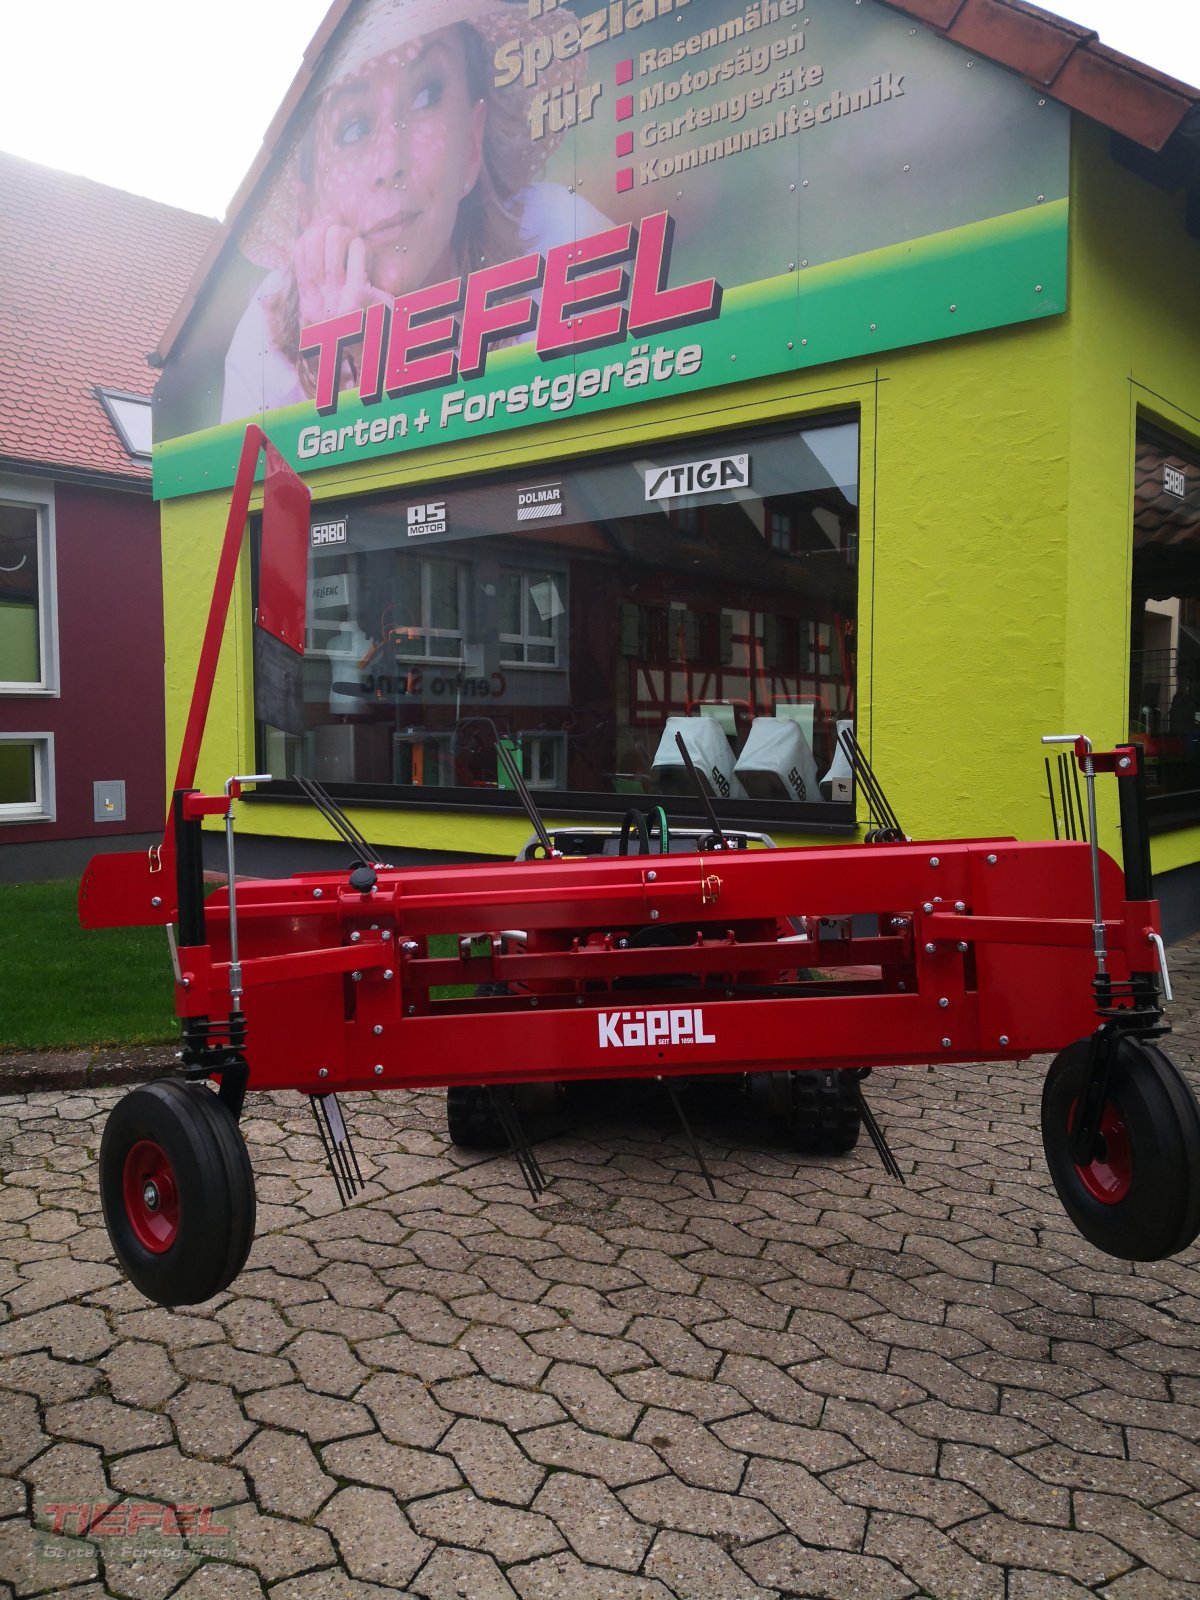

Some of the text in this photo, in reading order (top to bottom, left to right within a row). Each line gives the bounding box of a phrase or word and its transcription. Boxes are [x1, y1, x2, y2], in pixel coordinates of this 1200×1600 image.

[494, 0, 690, 87] Spezia
[639, 32, 805, 112] Motorsägen
[528, 81, 602, 141] für
[639, 63, 824, 148] Gartengeräte
[639, 71, 905, 186] Kommunaltechnik
[299, 210, 721, 415] TIEFEL
[297, 343, 702, 460] Garten + Forstgeräte
[518, 488, 561, 505] DOLMAR
[1164, 466, 1185, 498] SABO
[313, 522, 346, 545] SABO
[407, 502, 445, 524] AS
[409, 523, 444, 534] MOTOR
[711, 765, 731, 799] SAB
